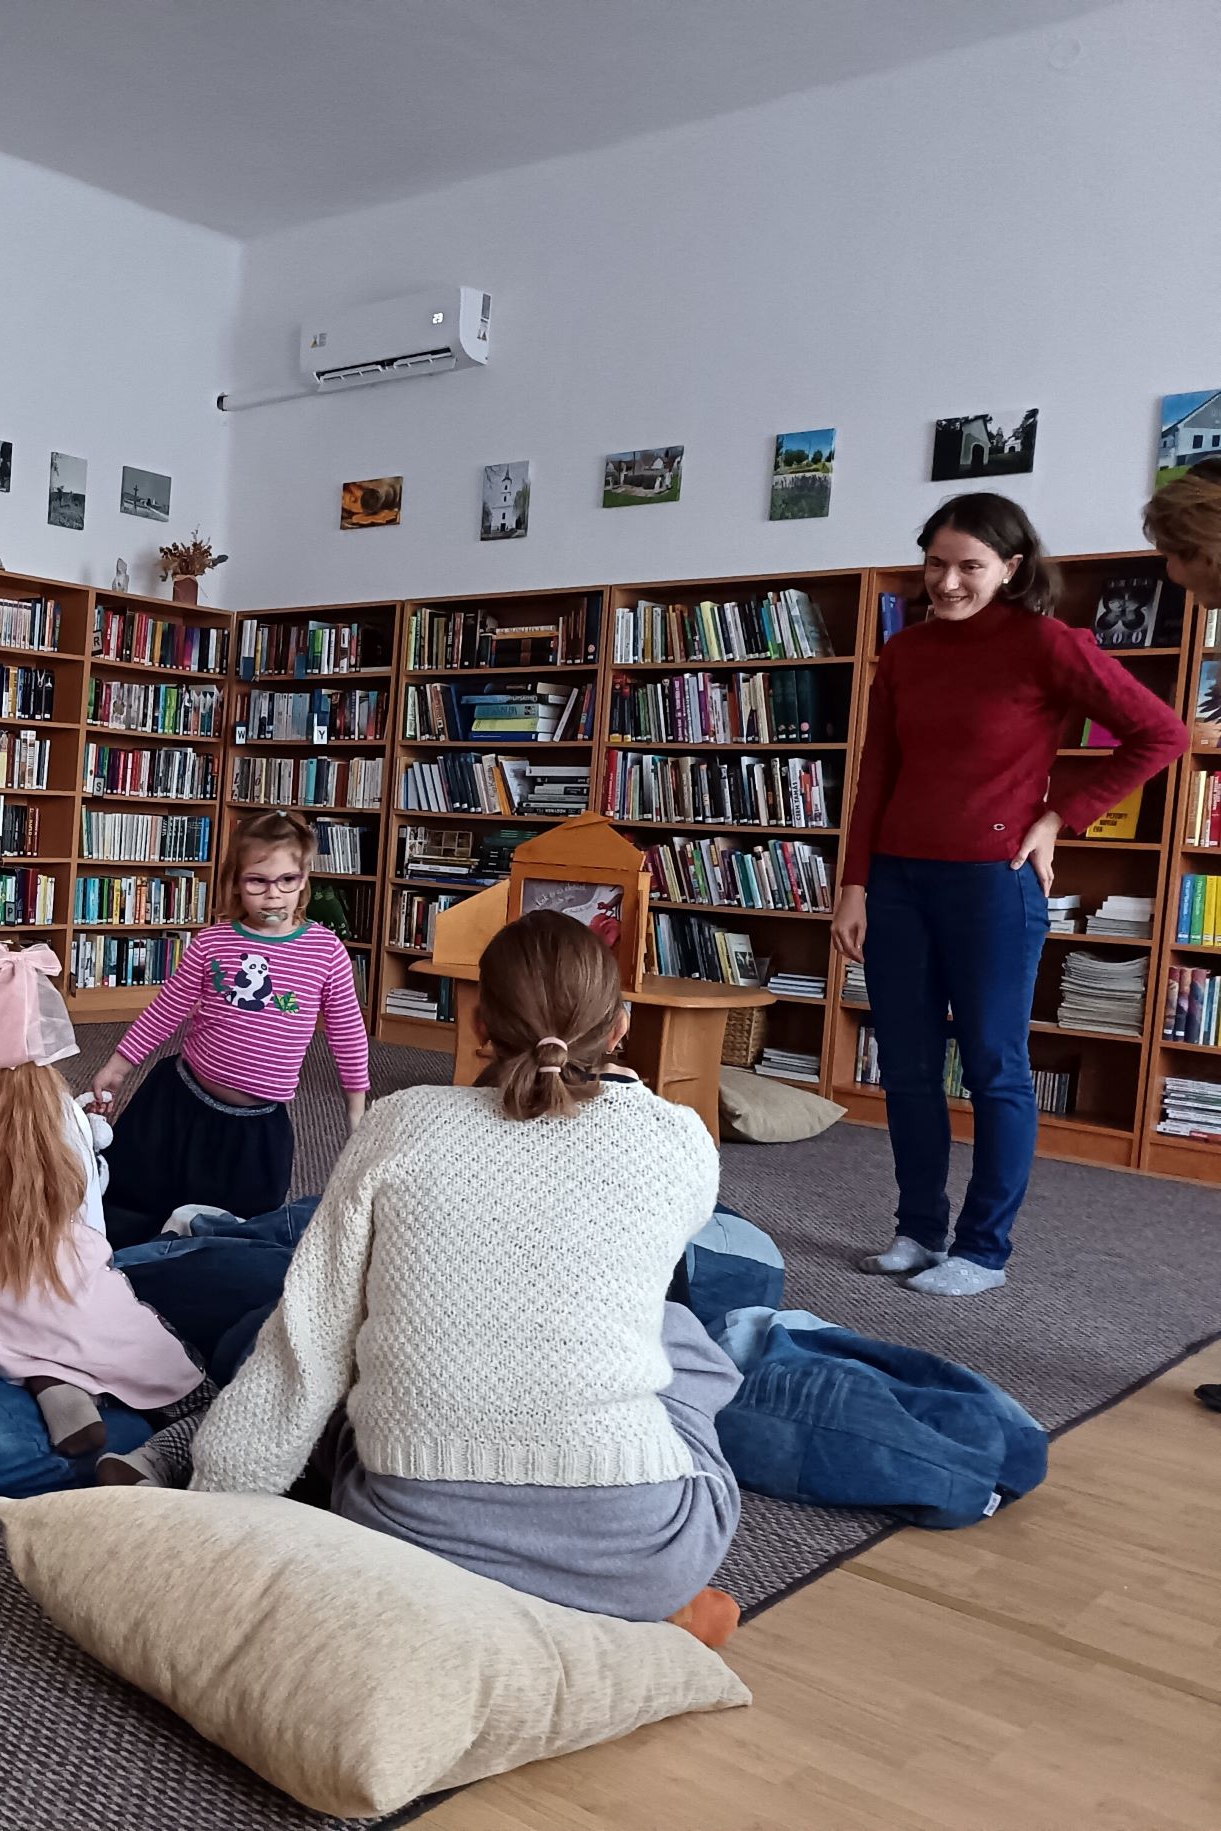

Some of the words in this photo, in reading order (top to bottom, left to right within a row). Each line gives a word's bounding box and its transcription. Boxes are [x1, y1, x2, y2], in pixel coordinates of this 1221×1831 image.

[93, 637, 100, 646] R
[237, 730, 245, 739] W
[318, 730, 326, 740] Y
[96, 782, 102, 792] S
[7, 907, 13, 917] P
